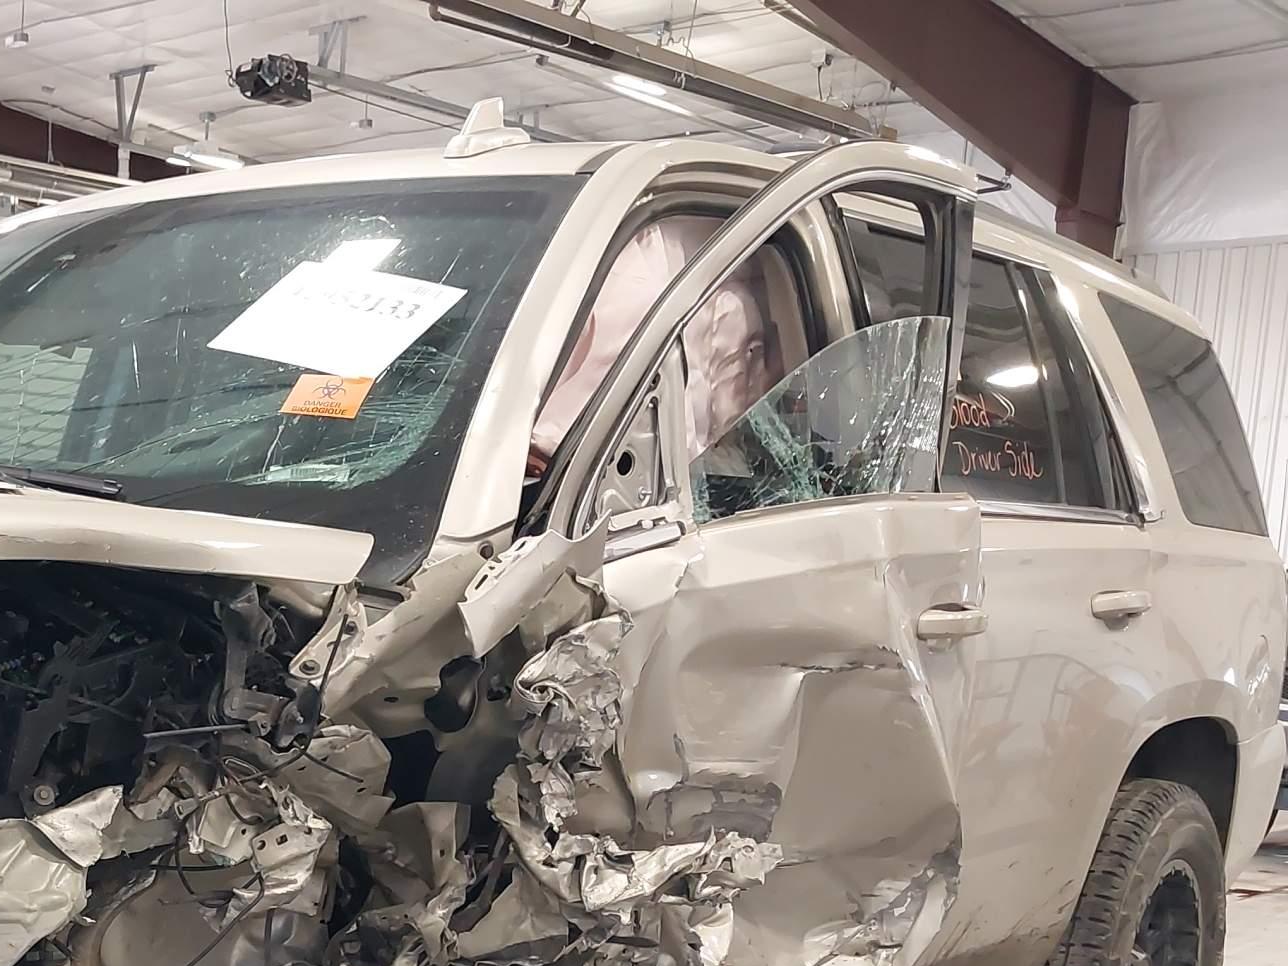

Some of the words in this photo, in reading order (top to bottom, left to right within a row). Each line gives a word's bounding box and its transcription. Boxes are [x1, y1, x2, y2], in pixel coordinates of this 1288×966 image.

[291, 406, 348, 416] BIOLOGIQUE
[952, 442, 1002, 475] Driver
[1004, 441, 1044, 480] Side
